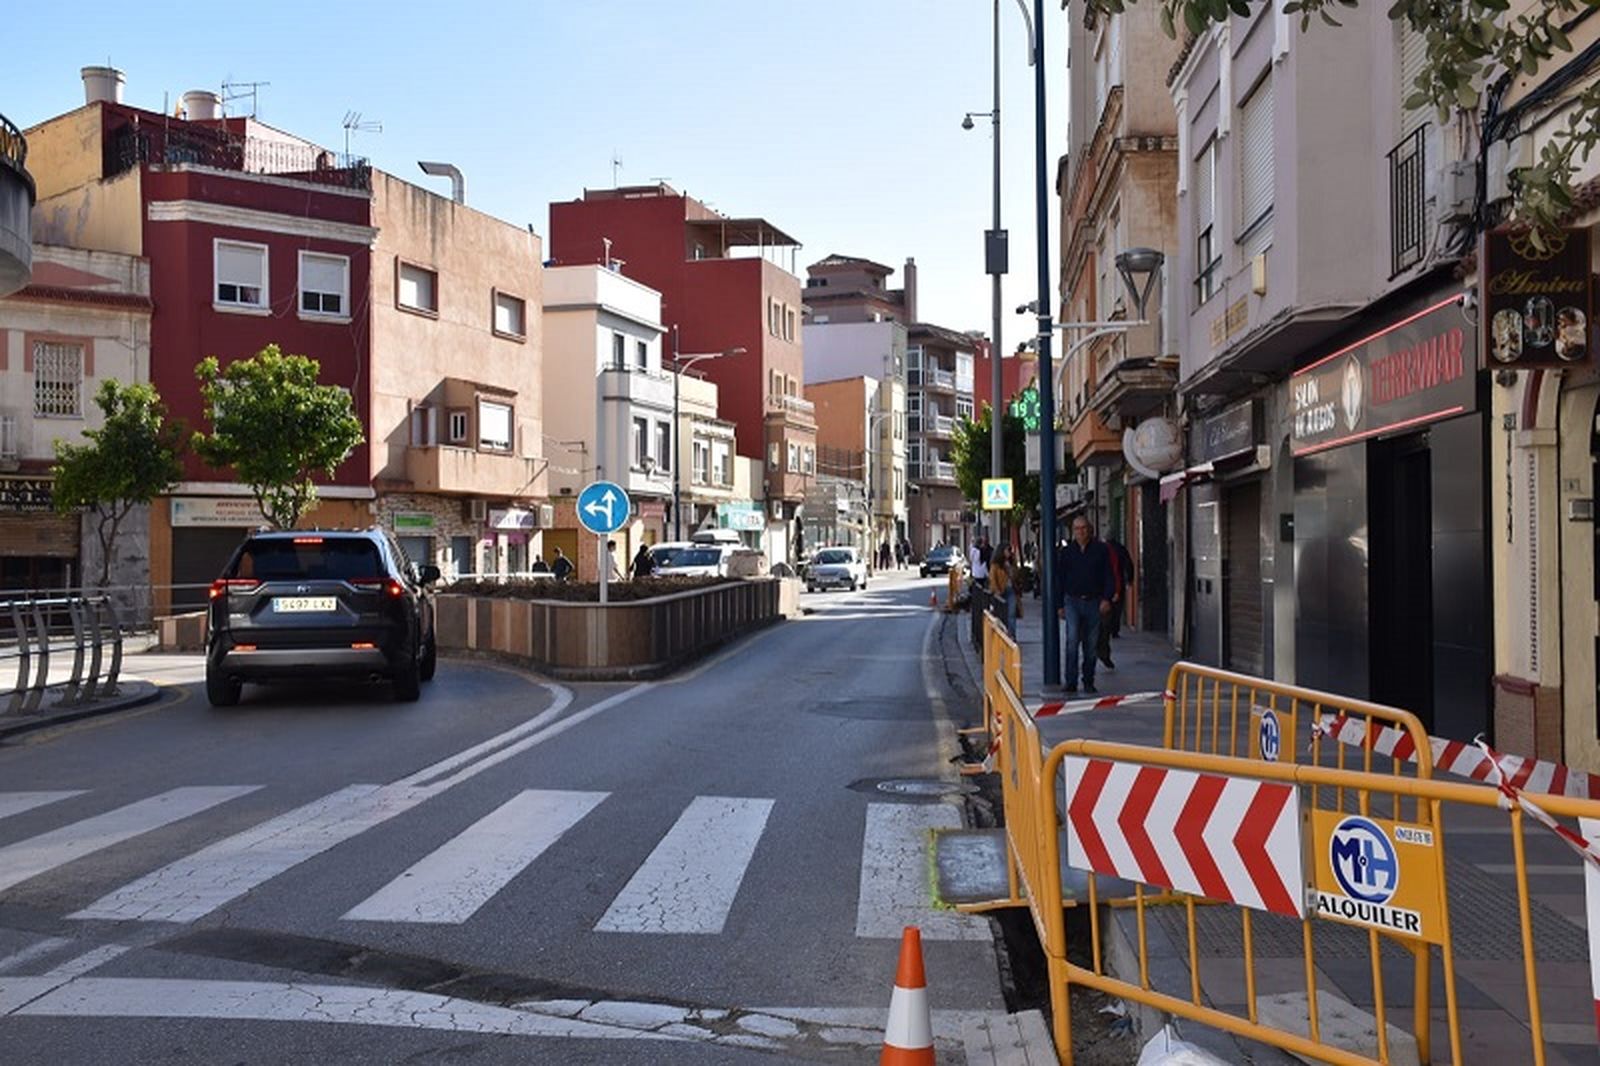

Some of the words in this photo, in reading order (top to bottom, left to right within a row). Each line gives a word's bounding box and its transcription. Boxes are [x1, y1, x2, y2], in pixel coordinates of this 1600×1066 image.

[1489, 268, 1584, 295] Amira
[1370, 327, 1466, 407] TERRAMAR
[1317, 894, 1419, 933] ALQUILER
